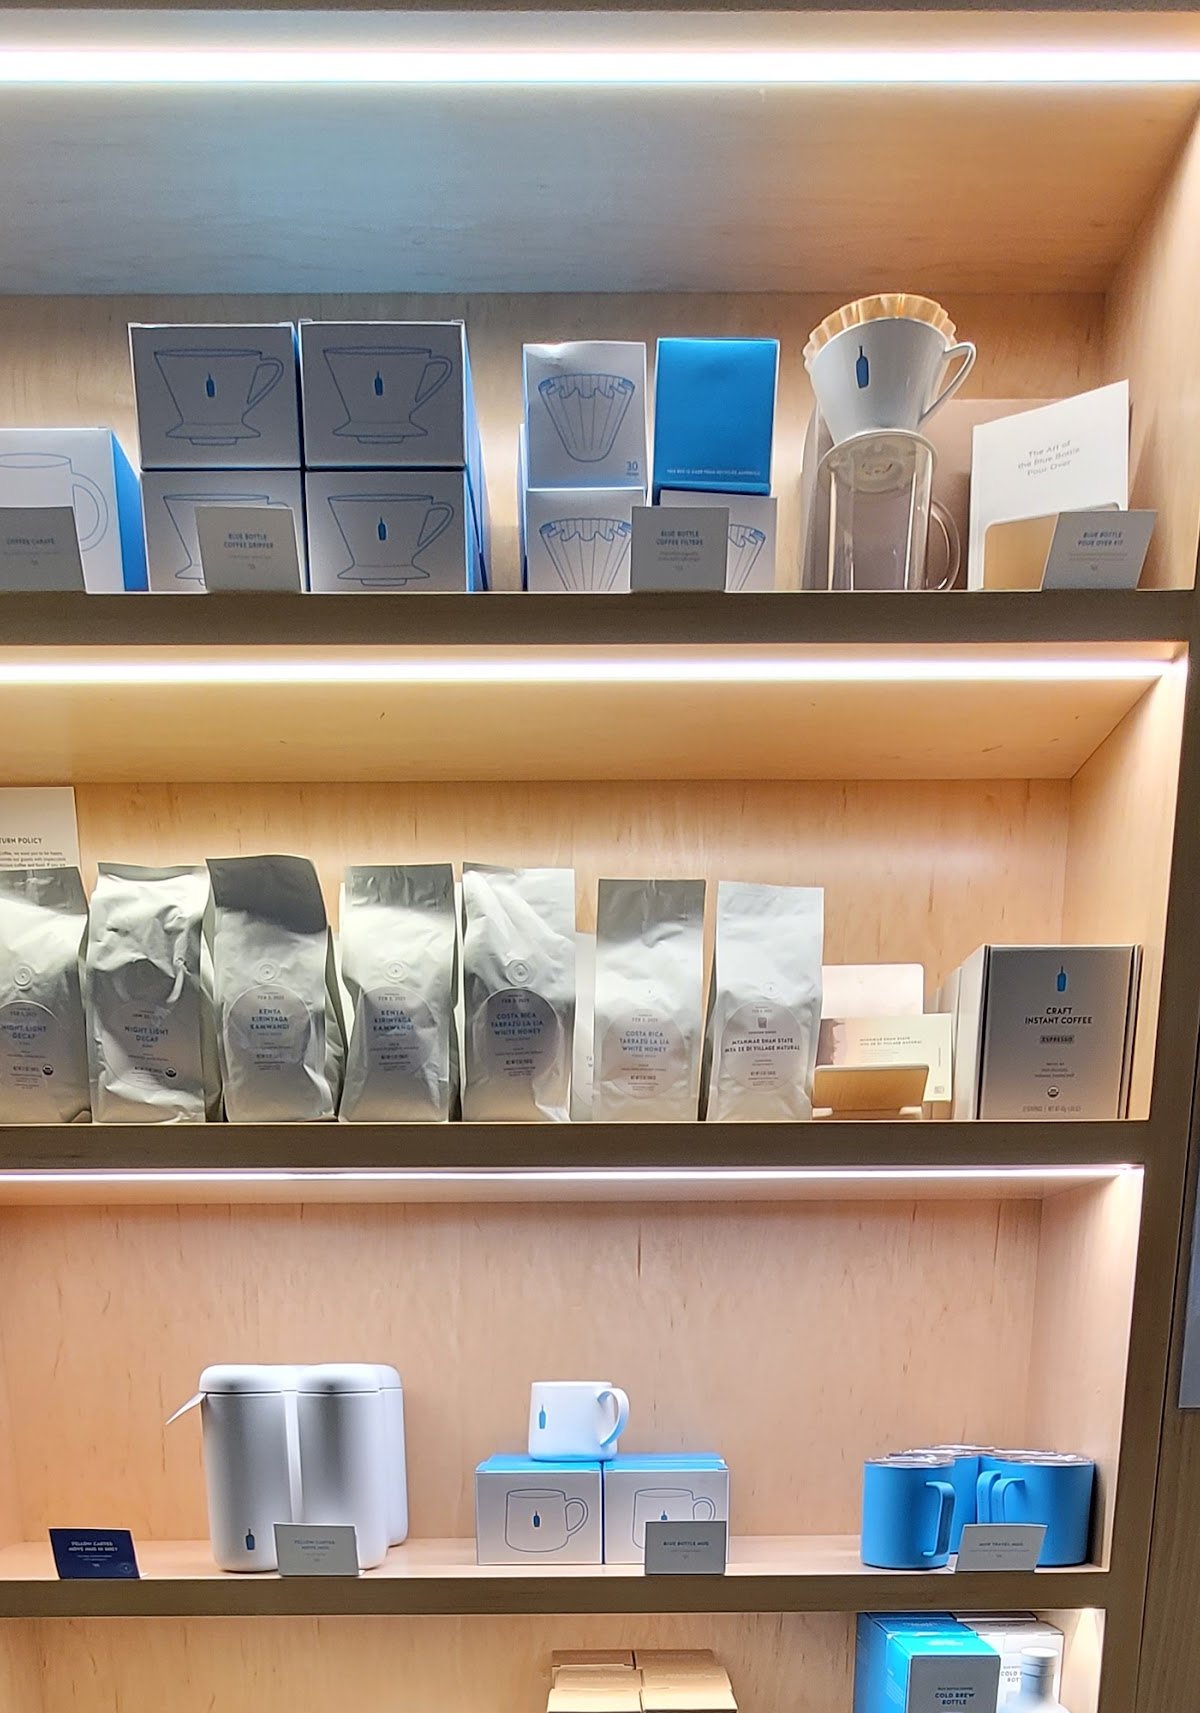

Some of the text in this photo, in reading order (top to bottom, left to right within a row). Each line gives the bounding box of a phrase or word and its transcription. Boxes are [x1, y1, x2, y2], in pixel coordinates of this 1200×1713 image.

[1028, 439, 1071, 457] The Art of
[1018, 447, 1080, 469] the Blue Bottle
[626, 460, 639, 471] 30
[1027, 459, 1071, 476] Pour Over
[1046, 1007, 1073, 1015] CRAFT
[1024, 1016, 1093, 1025] INSTANT COFFEE
[125, 1026, 169, 1036] NIGHT LIGHT
[1040, 1035, 1074, 1043] ESPRESSO
